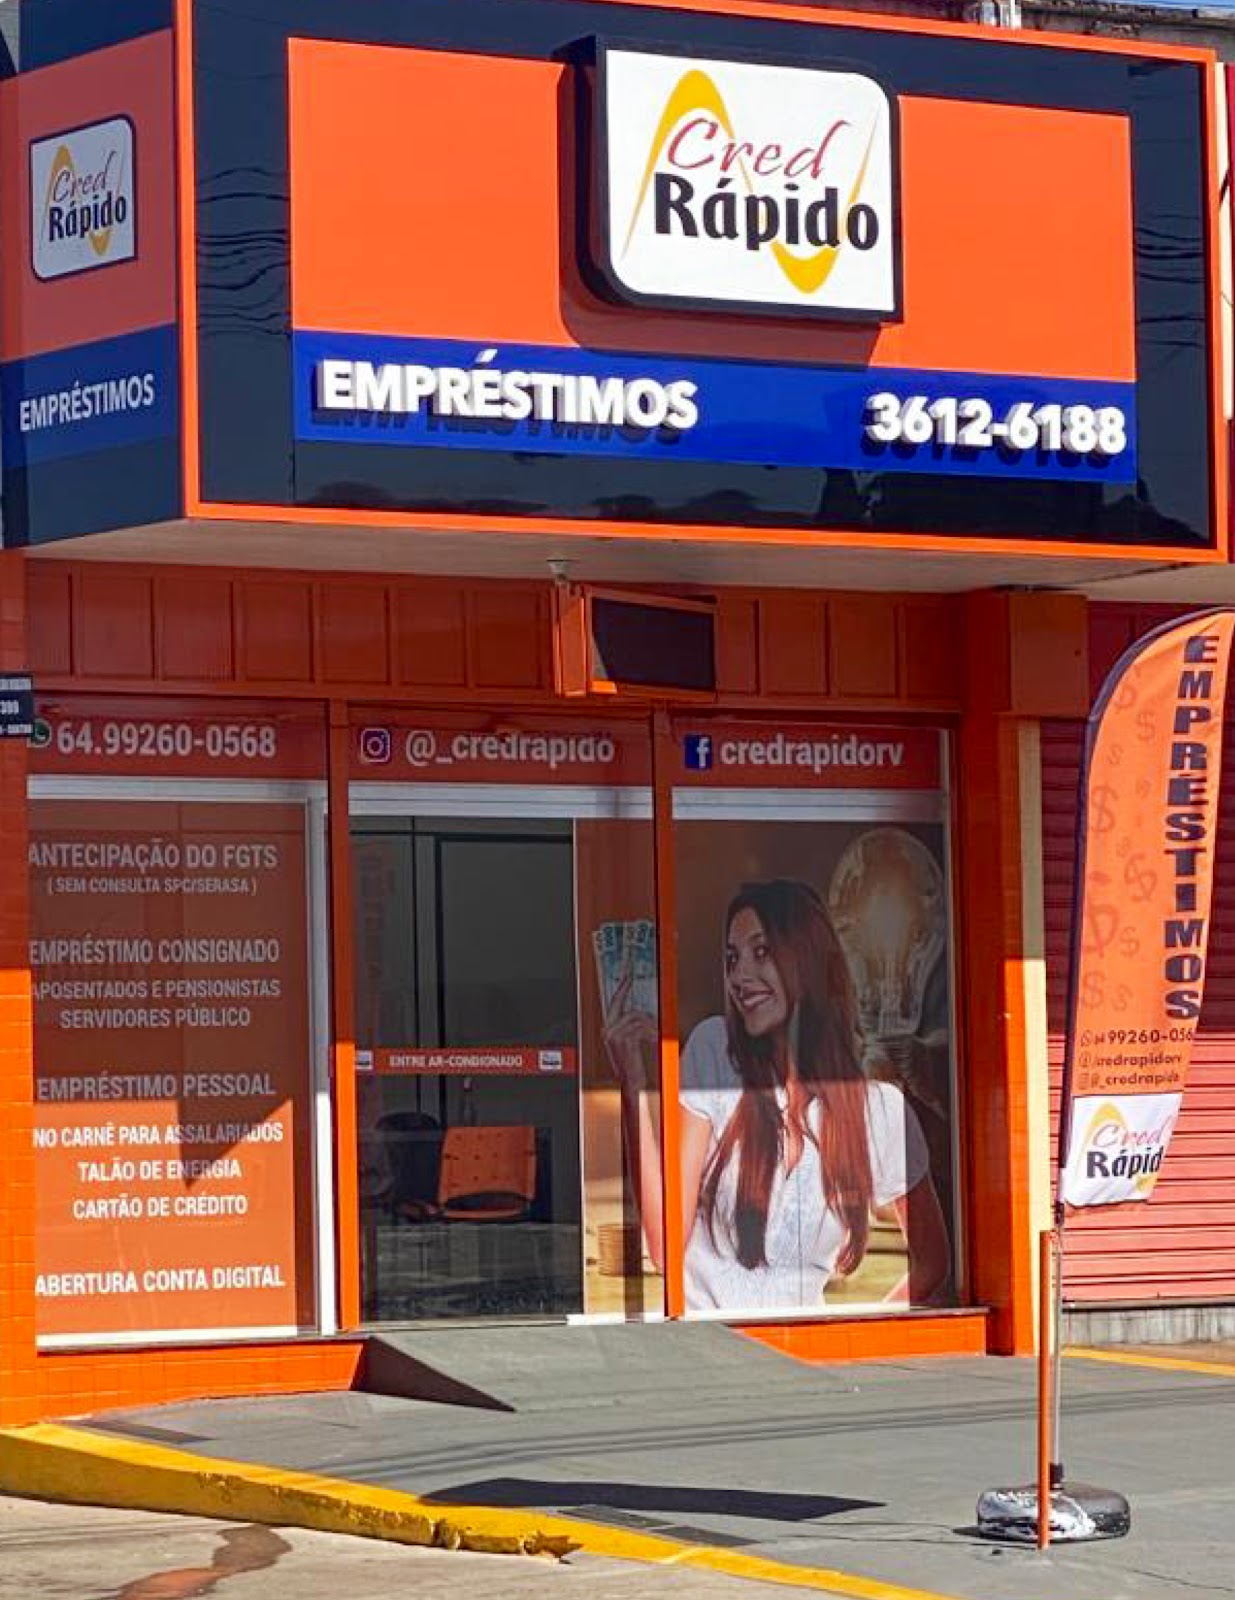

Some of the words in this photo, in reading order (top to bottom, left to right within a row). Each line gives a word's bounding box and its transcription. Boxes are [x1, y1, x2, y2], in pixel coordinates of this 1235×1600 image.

[667, 118, 852, 182] Cred
[52, 149, 118, 204] Cred
[48, 190, 128, 243] Rápido
[653, 172, 880, 252] Rápido
[19, 372, 155, 432] EMPRÉSTIMOS
[319, 348, 699, 431] EMPRÉSTIMOS
[865, 392, 1127, 456] 3612-6188
[56, 721, 277, 758] 64.99260-0568
[405, 730, 615, 770] @_credrapido
[720, 733, 905, 773] credrapidorv
[28, 838, 180, 874] ANTECIPAÇÃO
[186, 843, 217, 869] DO
[223, 843, 278, 869] FGTS
[90, 877, 160, 893] CONSULTA
[30, 932, 152, 964] EMPRÉSTIMO
[158, 938, 280, 963] CONSIGNADO
[153, 980, 161, 998] E
[166, 978, 281, 998] PENSIONISTAS
[60, 1008, 170, 1029] SERVIDORES
[175, 1002, 251, 1028] PÚBLICO
[389, 1055, 426, 1068] ENTRE
[36, 1071, 177, 1100] EMPRÉSTIMO
[182, 1072, 276, 1097] PESSOAL
[33, 1127, 56, 1148] NO
[61, 1122, 114, 1146] CARNÊ
[119, 1125, 160, 1144] PARA
[164, 1122, 283, 1144] ASSALARIADOS
[1092, 1114, 1174, 1148] Cred
[78, 1157, 134, 1182] TALÃO
[139, 1161, 162, 1180] DE
[167, 1159, 242, 1180] ENERGIA
[73, 1191, 142, 1219] CARTÃO
[147, 1198, 169, 1217] DE
[174, 1192, 248, 1216] CRÉDITO
[34, 1270, 139, 1298] ABERTURA
[143, 1268, 206, 1293] CONTA
[212, 1264, 286, 1289] DIGITAL
